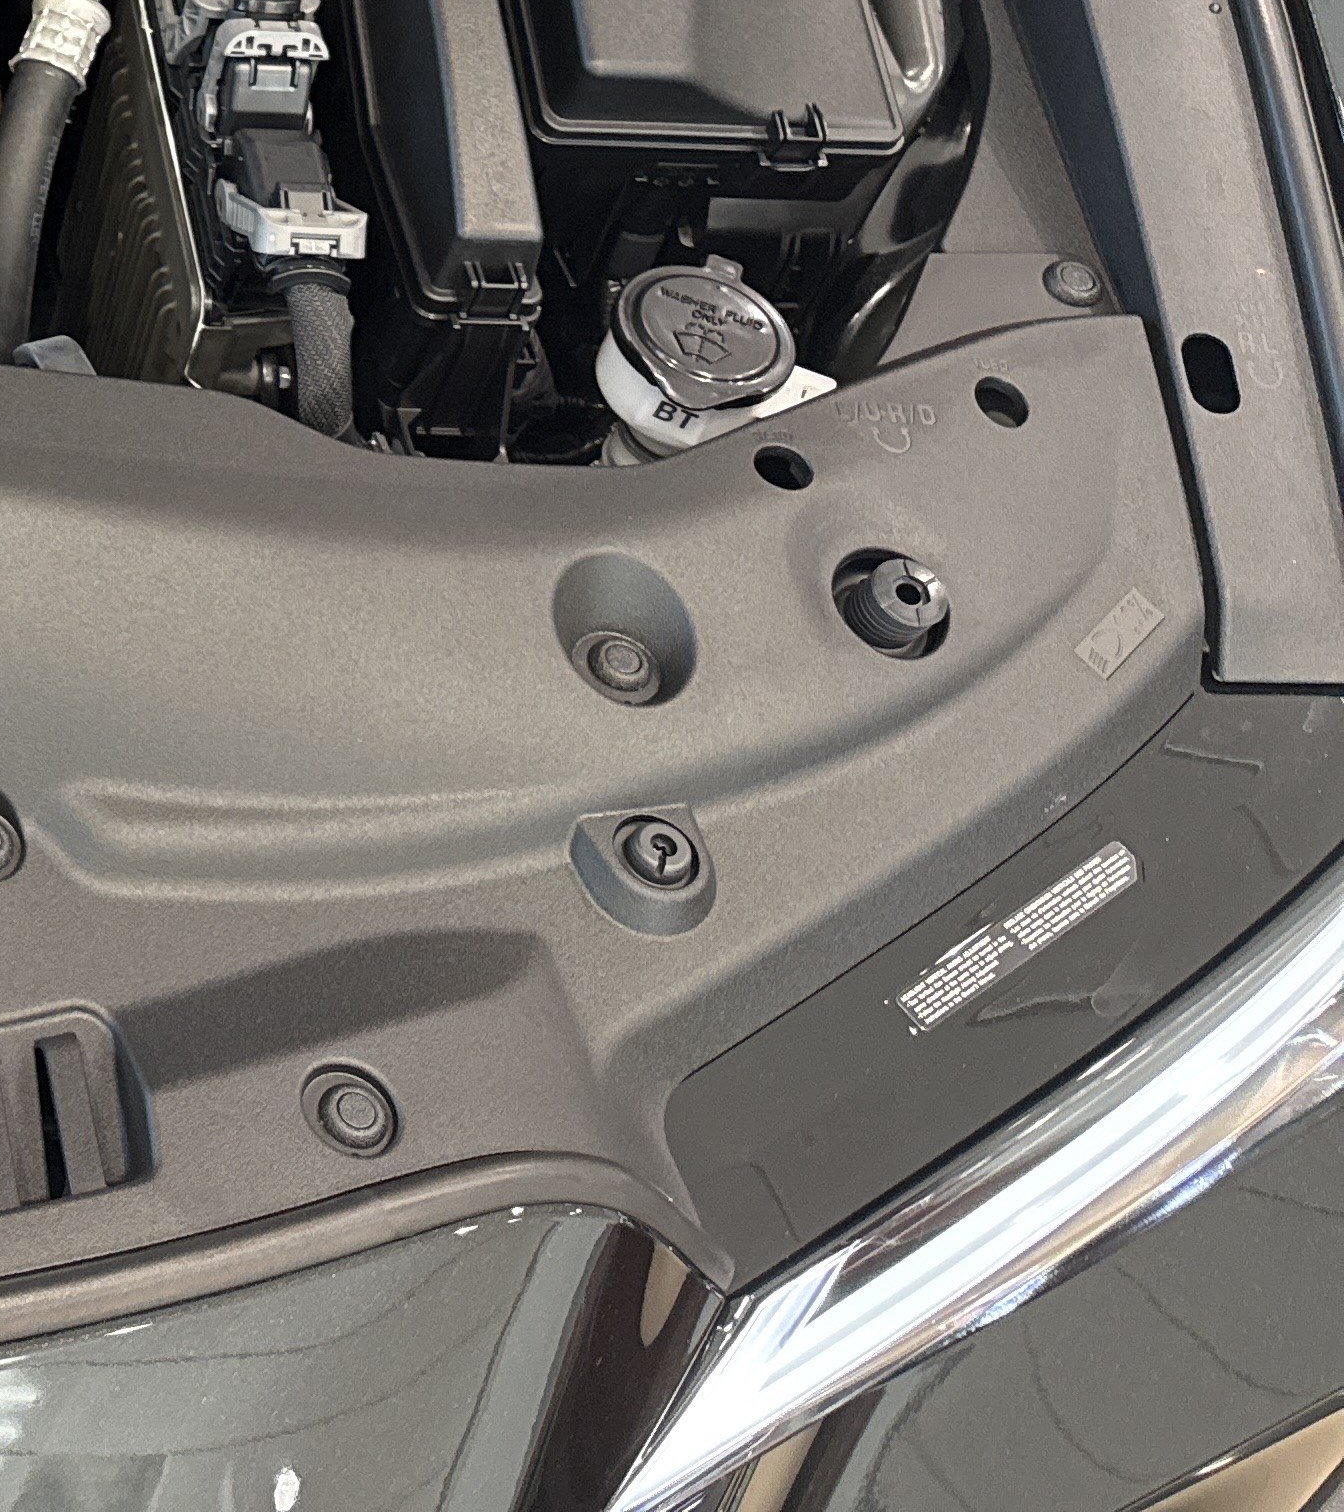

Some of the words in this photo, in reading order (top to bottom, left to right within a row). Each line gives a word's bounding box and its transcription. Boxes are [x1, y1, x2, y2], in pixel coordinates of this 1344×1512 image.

[659, 286, 717, 315] WASHER
[724, 306, 765, 332] FLUID
[691, 309, 728, 327] ONLY
[652, 400, 700, 430] BT
